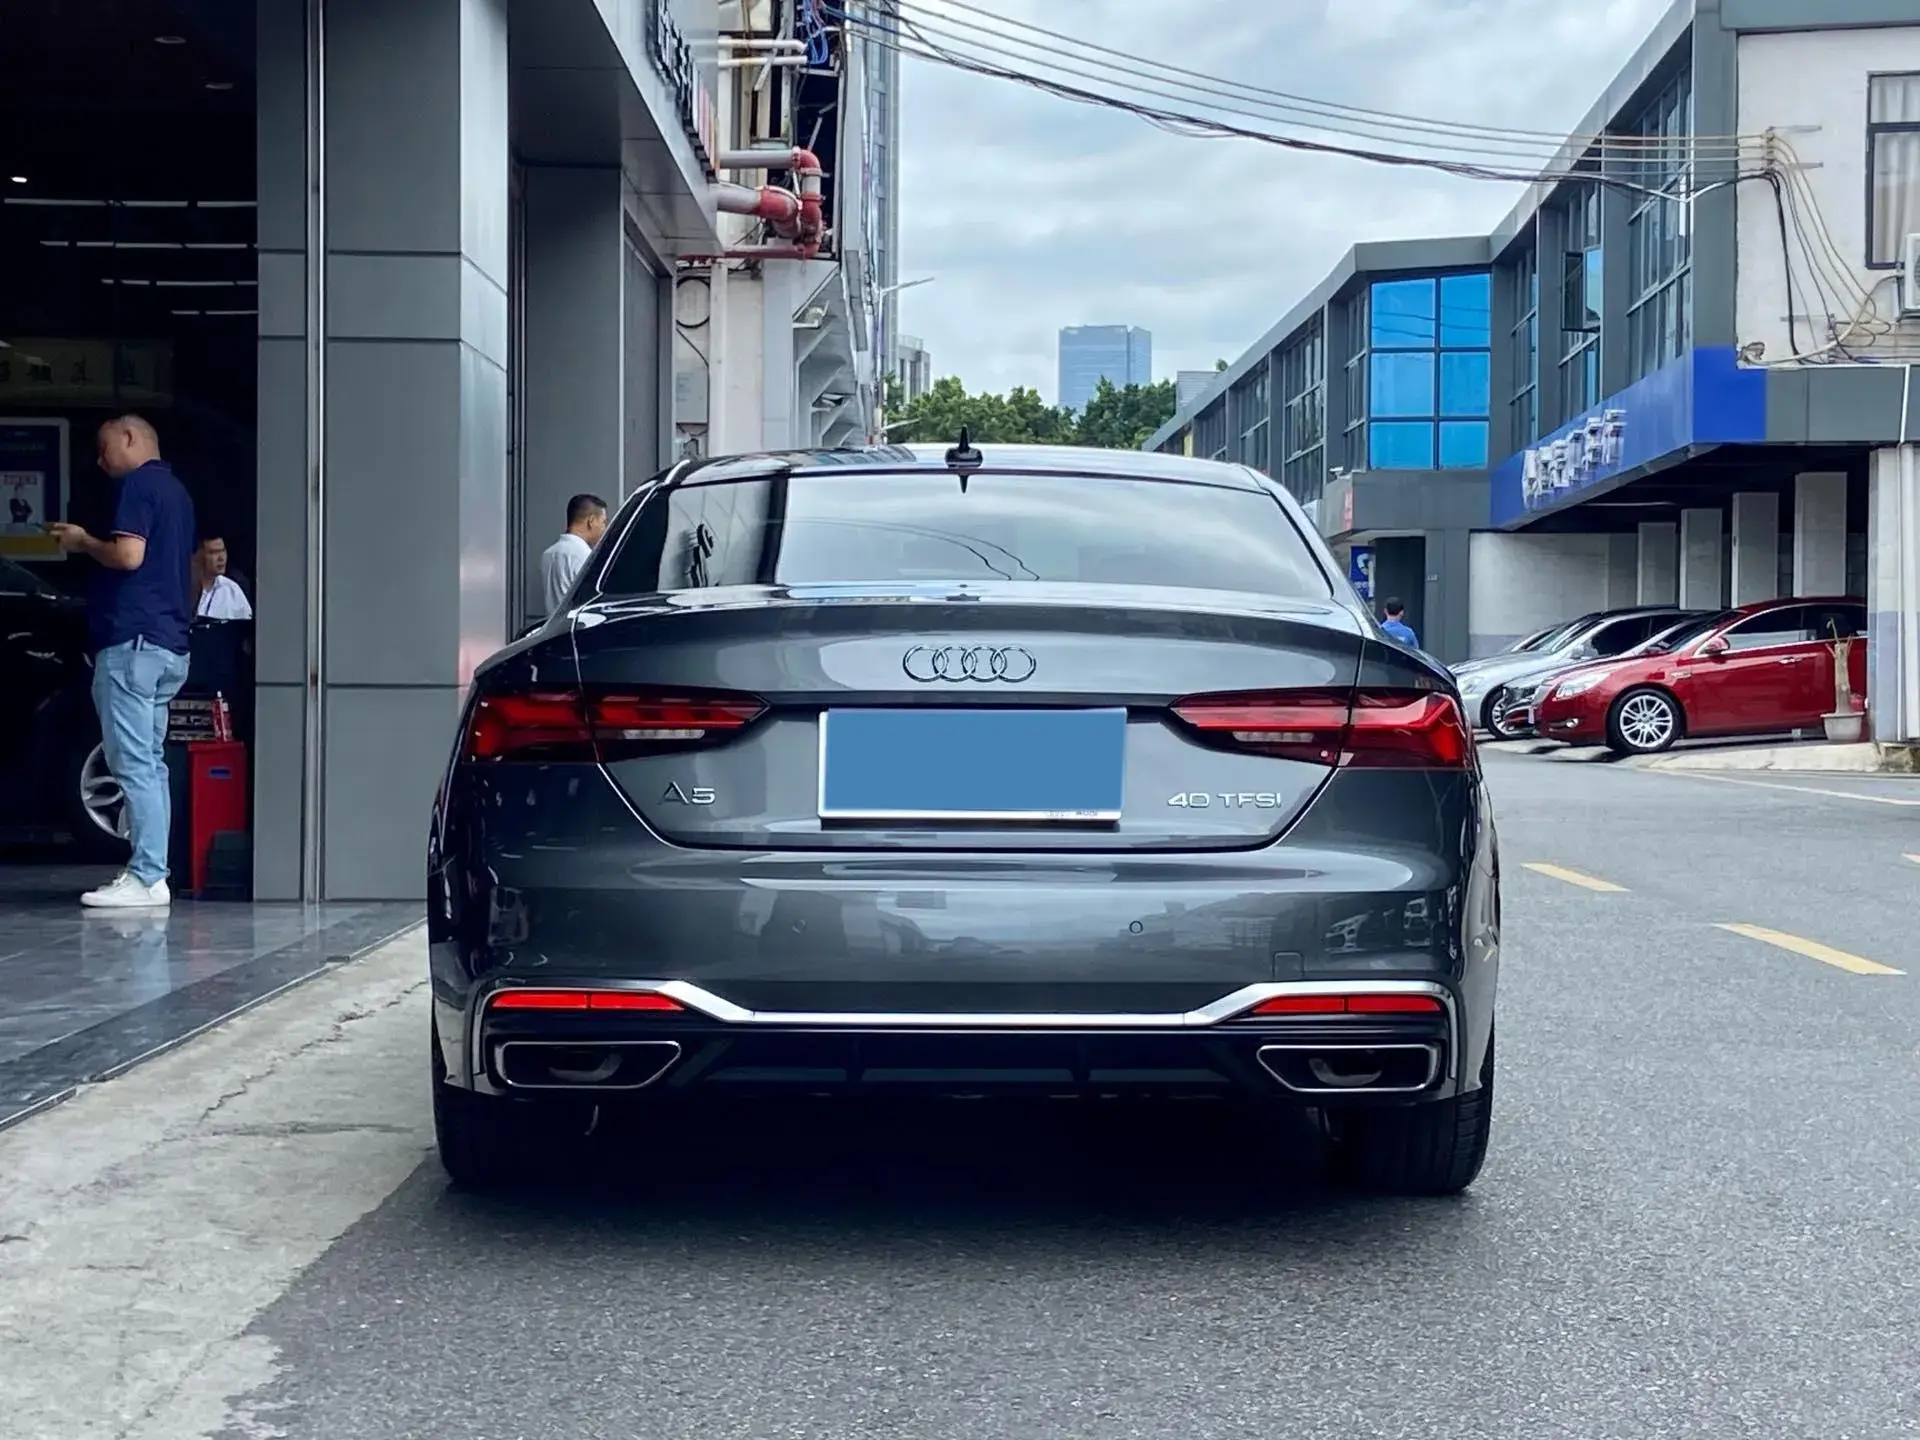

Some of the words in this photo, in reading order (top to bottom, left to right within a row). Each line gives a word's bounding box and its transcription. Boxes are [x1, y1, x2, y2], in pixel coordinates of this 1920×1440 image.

[663, 780, 716, 806] A5
[1166, 792, 1210, 809] 40
[1216, 792, 1283, 809] TFSI
